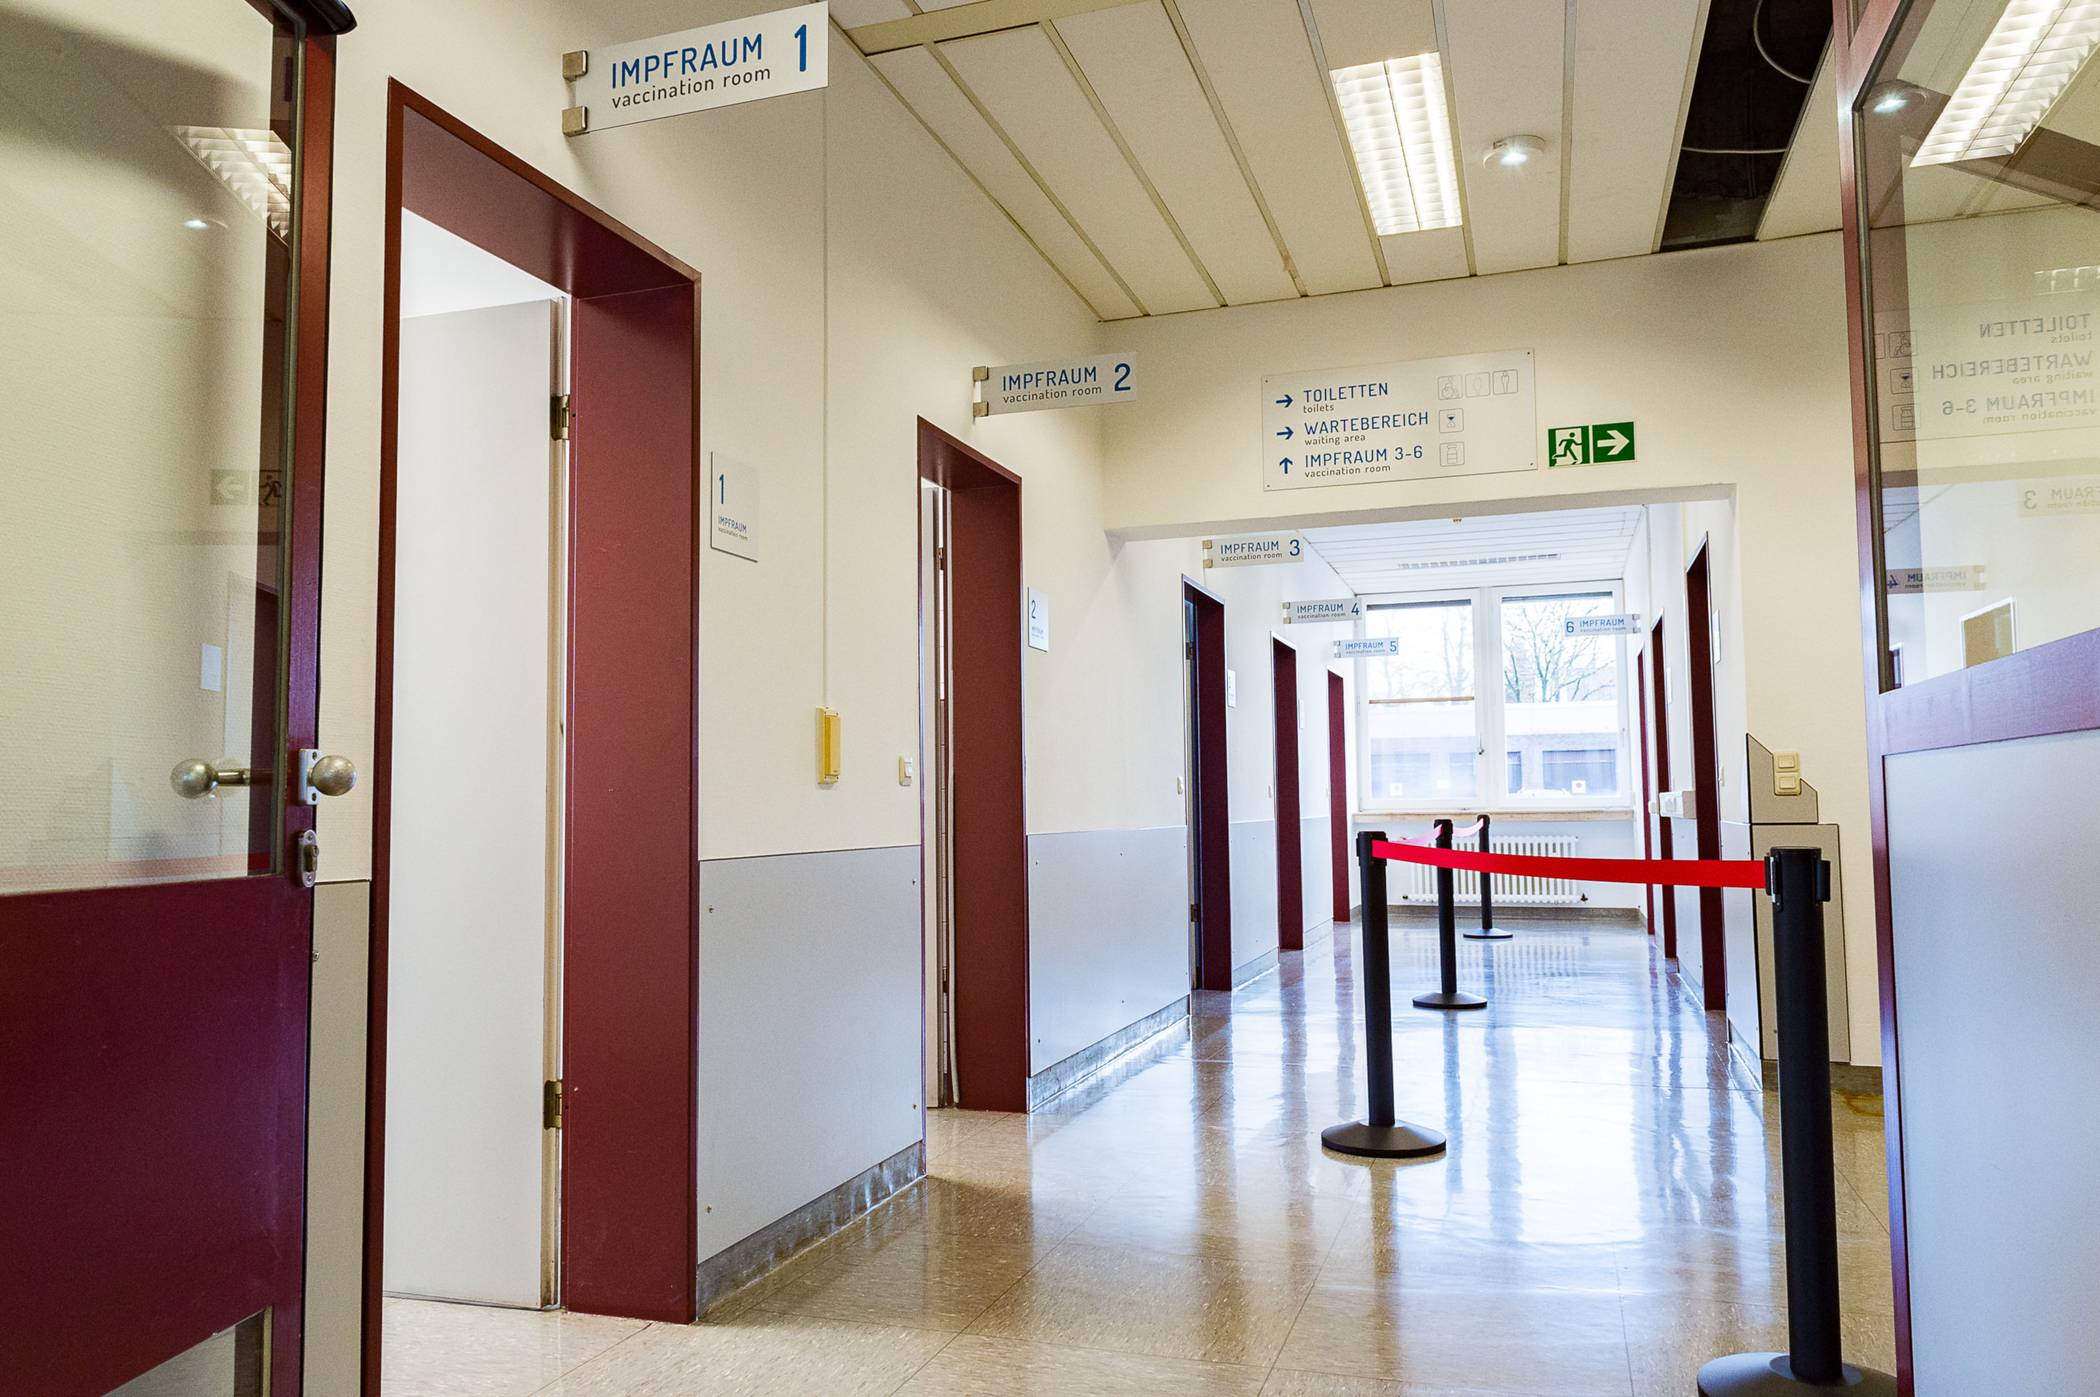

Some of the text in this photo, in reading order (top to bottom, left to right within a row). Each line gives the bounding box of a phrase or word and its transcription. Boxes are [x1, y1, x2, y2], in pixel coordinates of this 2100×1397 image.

[611, 24, 807, 89] IMPFRAUM 1
[611, 68, 771, 109] vaccination room
[1002, 362, 1131, 392] IMPFRAUM 2
[1002, 385, 1102, 404] vaccination room
[1303, 382, 1388, 403] TOILETTEN
[1303, 403, 1335, 414] toilets
[1304, 411, 1429, 435] WARTEBEREICH
[1304, 434, 1366, 446] waiting area
[1305, 445, 1424, 468] IMPFRAUM 3-6
[1304, 464, 1391, 478] vaccination room
[719, 474, 725, 505] 1
[1220, 539, 1301, 557] IMPFRAUM 3
[1221, 553, 1262, 561] vaccination
[1296, 602, 1360, 616] IMPFRAUM 4
[1566, 621, 1575, 633] 6
[1580, 618, 1625, 627] IMPFRAUM
[1344, 641, 1384, 650] IMPFRAUM
[1389, 640, 1397, 652] 5
